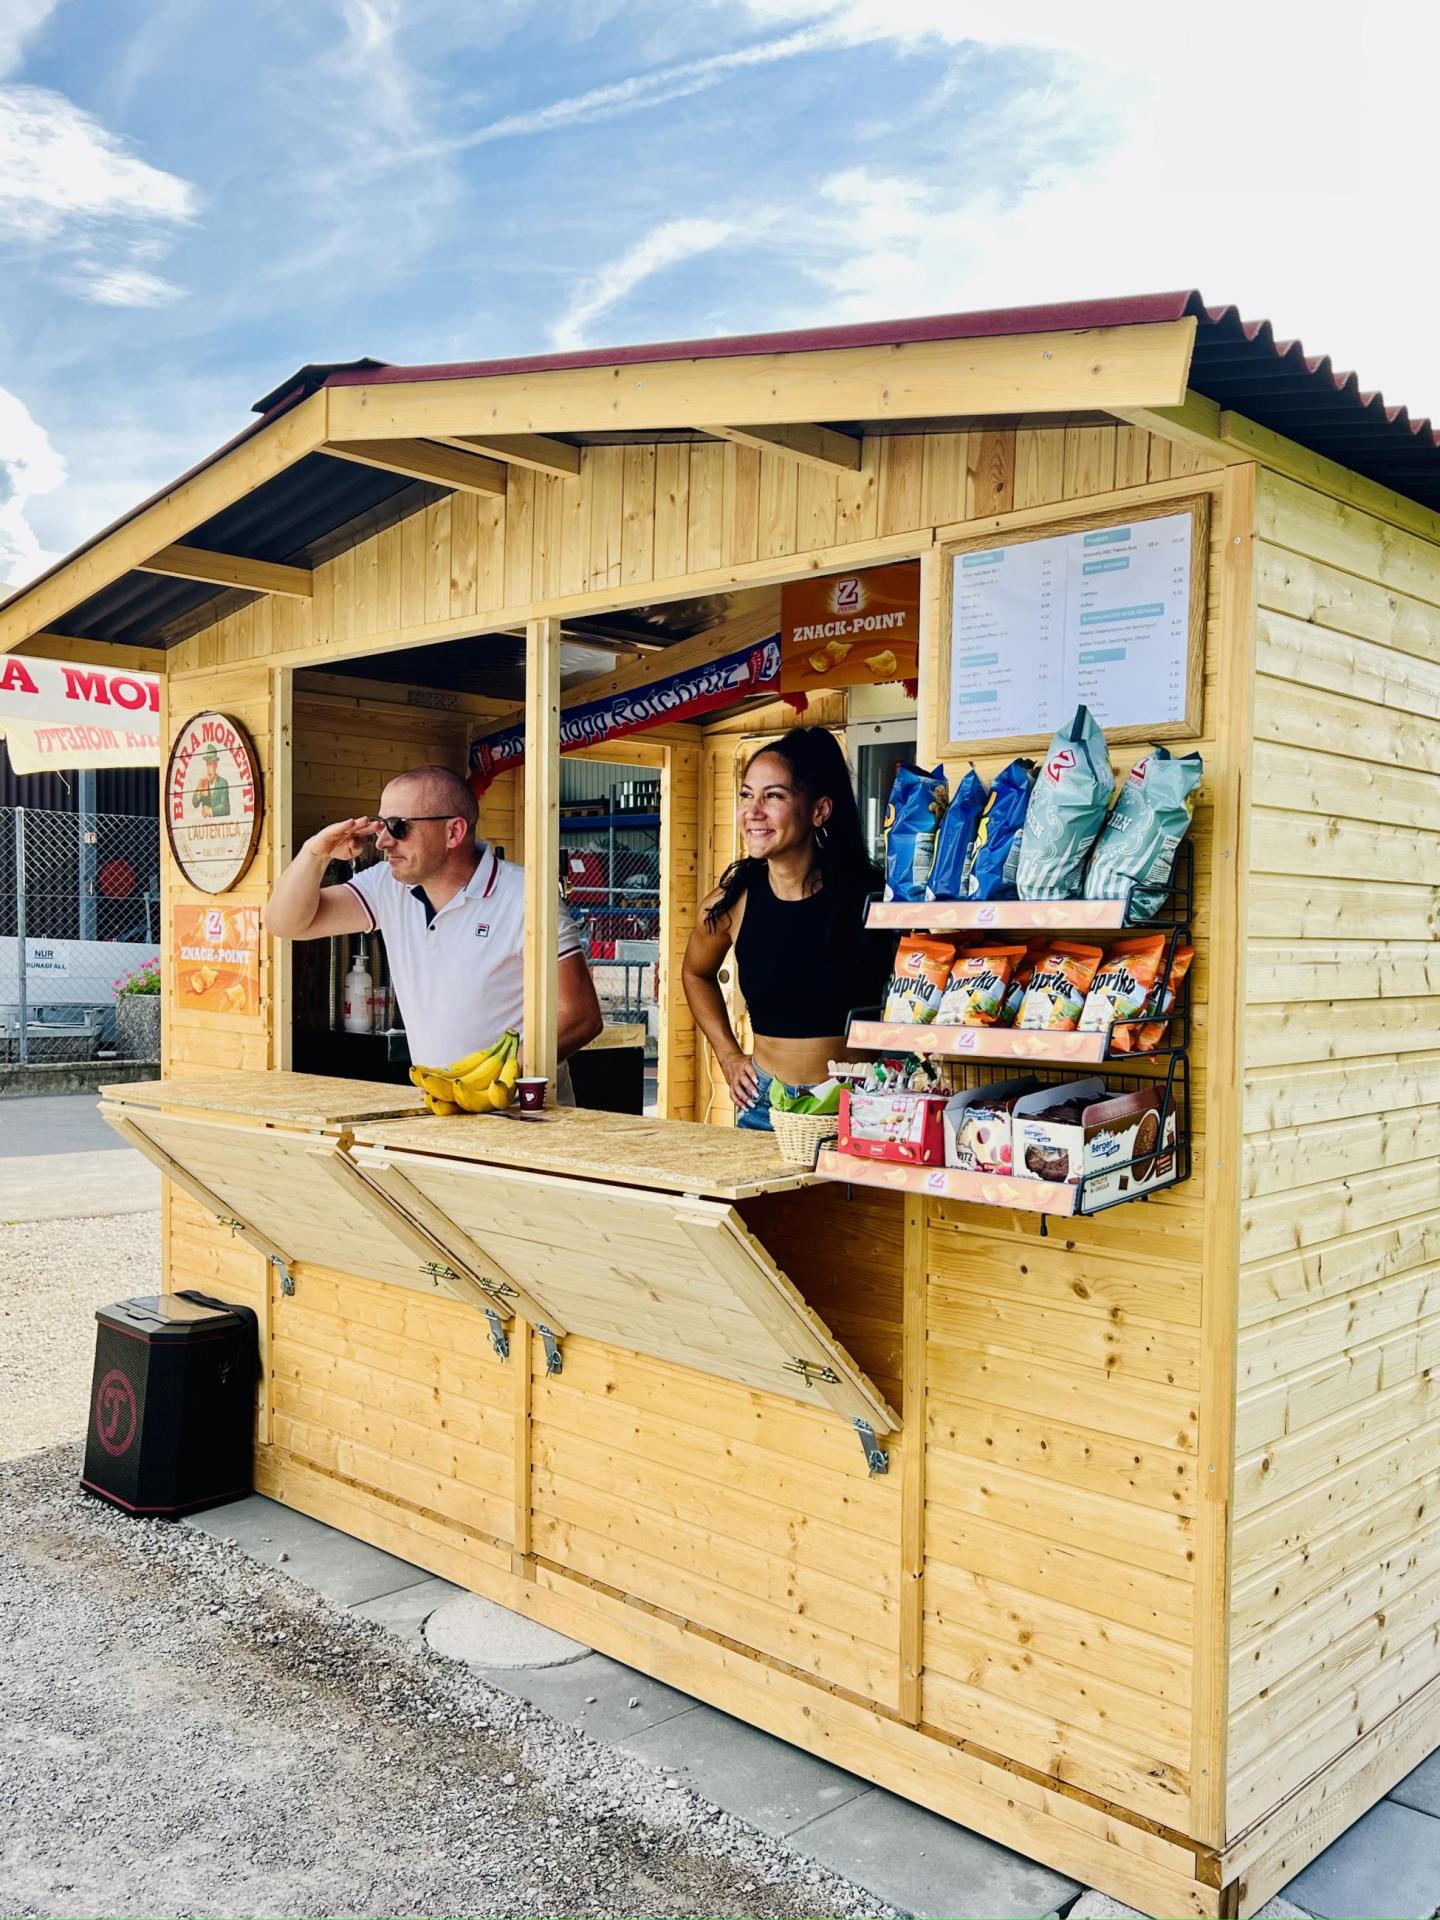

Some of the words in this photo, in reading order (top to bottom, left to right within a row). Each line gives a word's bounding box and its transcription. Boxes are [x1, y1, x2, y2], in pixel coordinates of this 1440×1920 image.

[838, 579, 858, 606] Z
[793, 612, 906, 641] ZNACK-POINT
[173, 731, 201, 820] BIRRA
[201, 721, 255, 814] MORETTI
[34, 950, 54, 958] NUR
[1091, 1139, 1113, 1153] Berger
